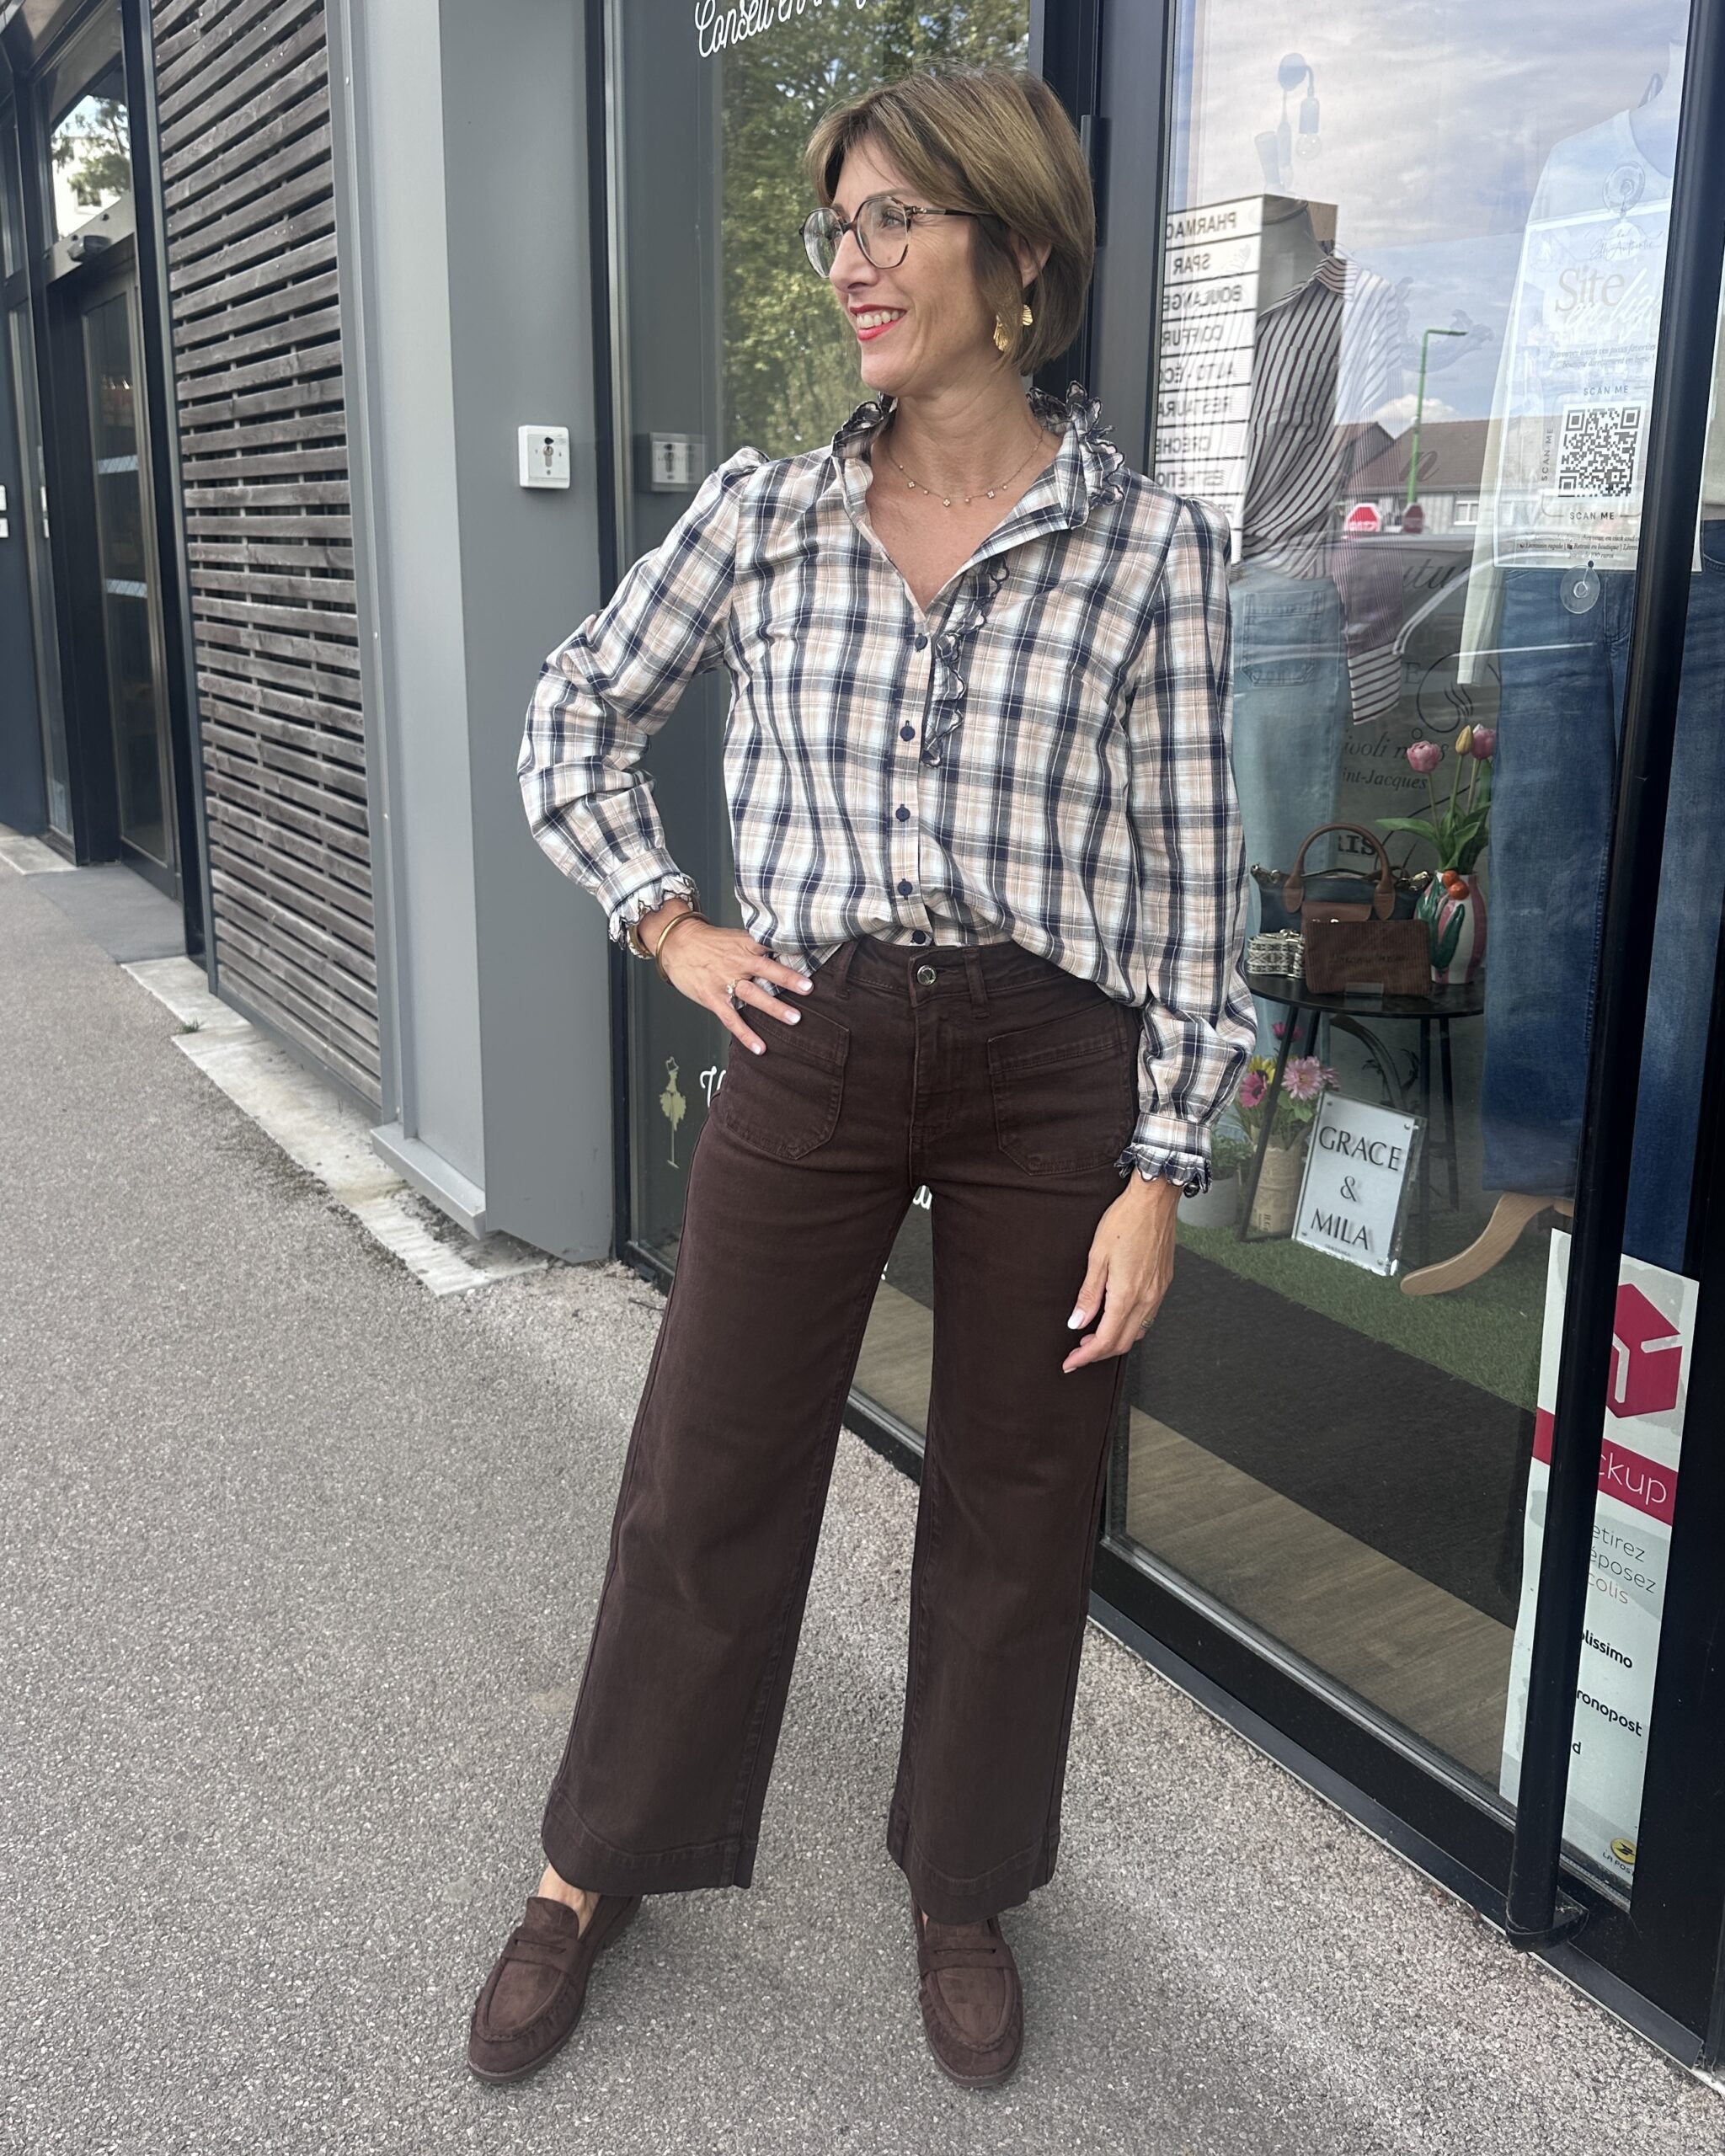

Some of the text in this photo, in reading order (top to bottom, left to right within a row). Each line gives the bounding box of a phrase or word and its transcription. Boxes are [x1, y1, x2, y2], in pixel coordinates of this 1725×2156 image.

[1555, 264, 1625, 312] Site
[1583, 385, 1629, 396] SCAN ME
[1541, 428, 1554, 482] SCAN ME
[1569, 511, 1615, 520] SCAN ME
[1318, 1125, 1402, 1171] GRACE
[1339, 1175, 1358, 1203] &
[1311, 1208, 1369, 1251] MILA
[1588, 1572, 1629, 1604] colis
[1614, 1859, 1634, 1876] POS
